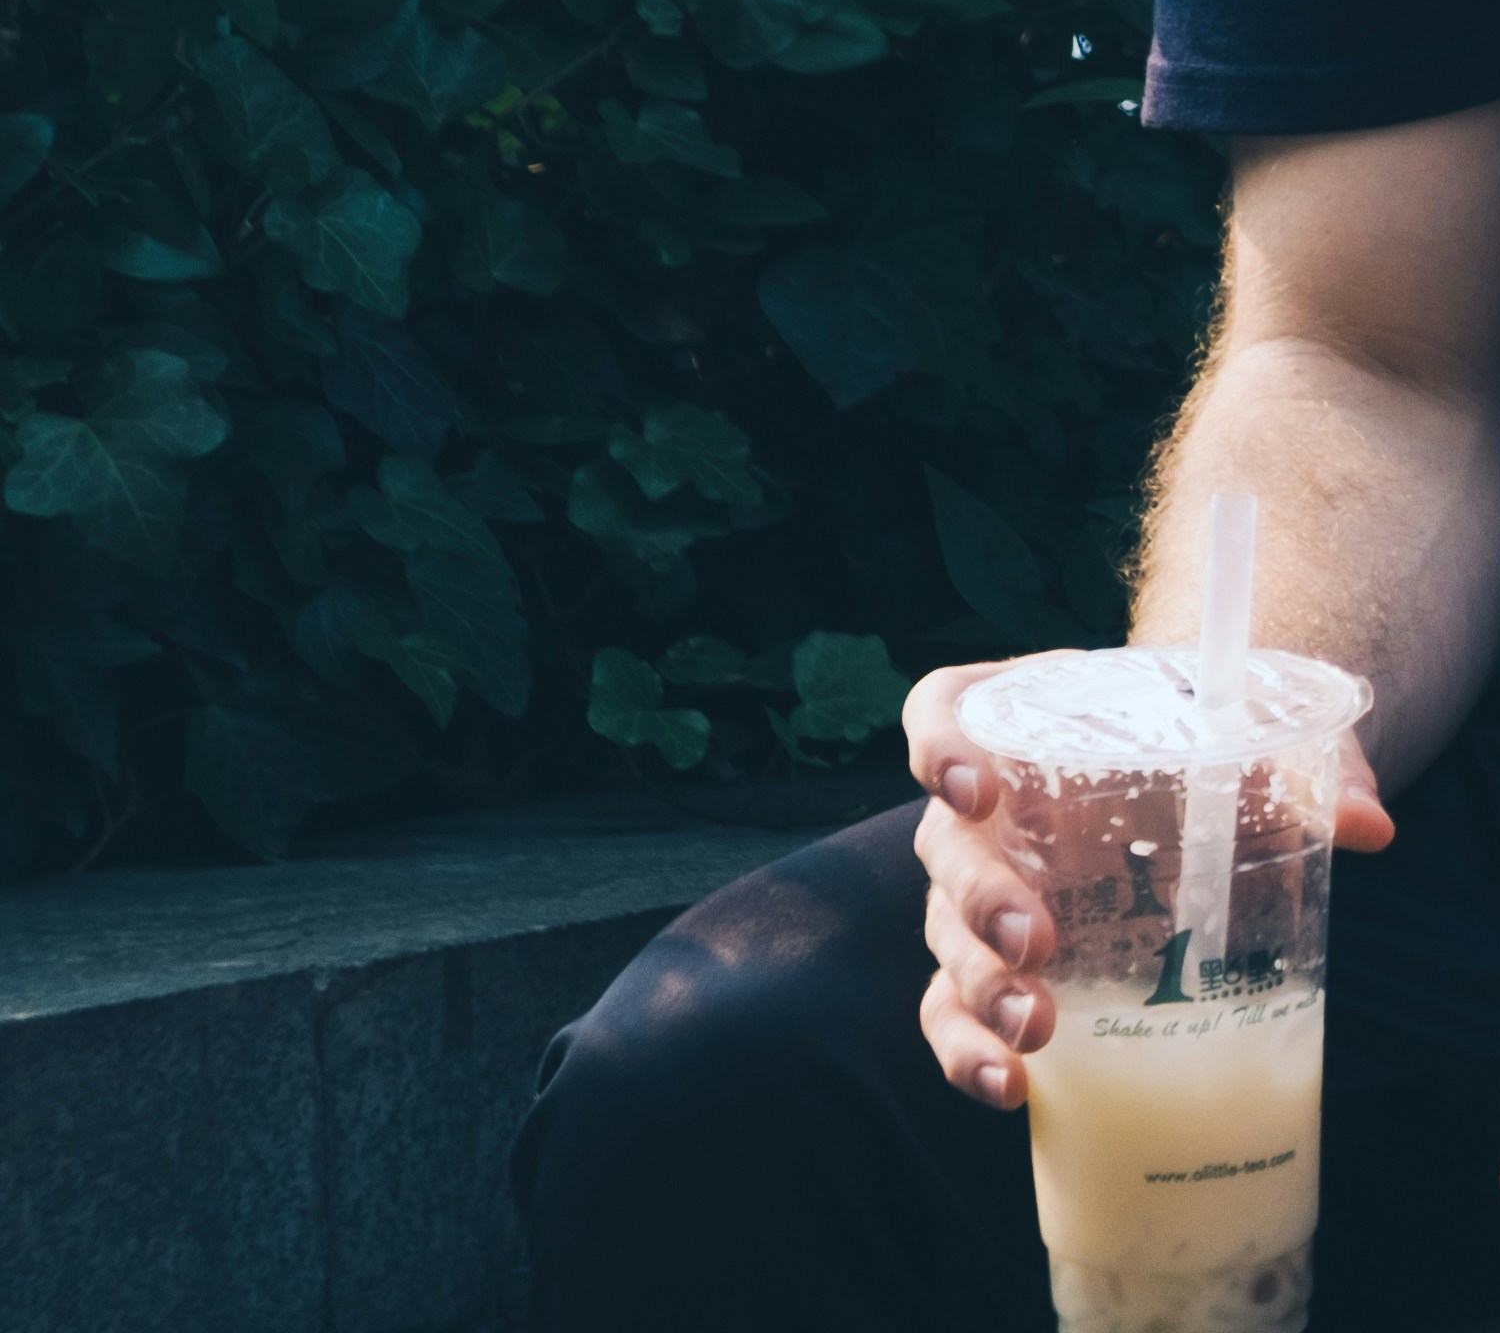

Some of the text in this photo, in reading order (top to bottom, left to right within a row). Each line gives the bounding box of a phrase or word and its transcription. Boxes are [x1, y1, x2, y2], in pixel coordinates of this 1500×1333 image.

[1093, 1016, 1153, 1038] Shake
[1163, 1019, 1178, 1037] it
[1187, 1011, 1222, 1039] up!
